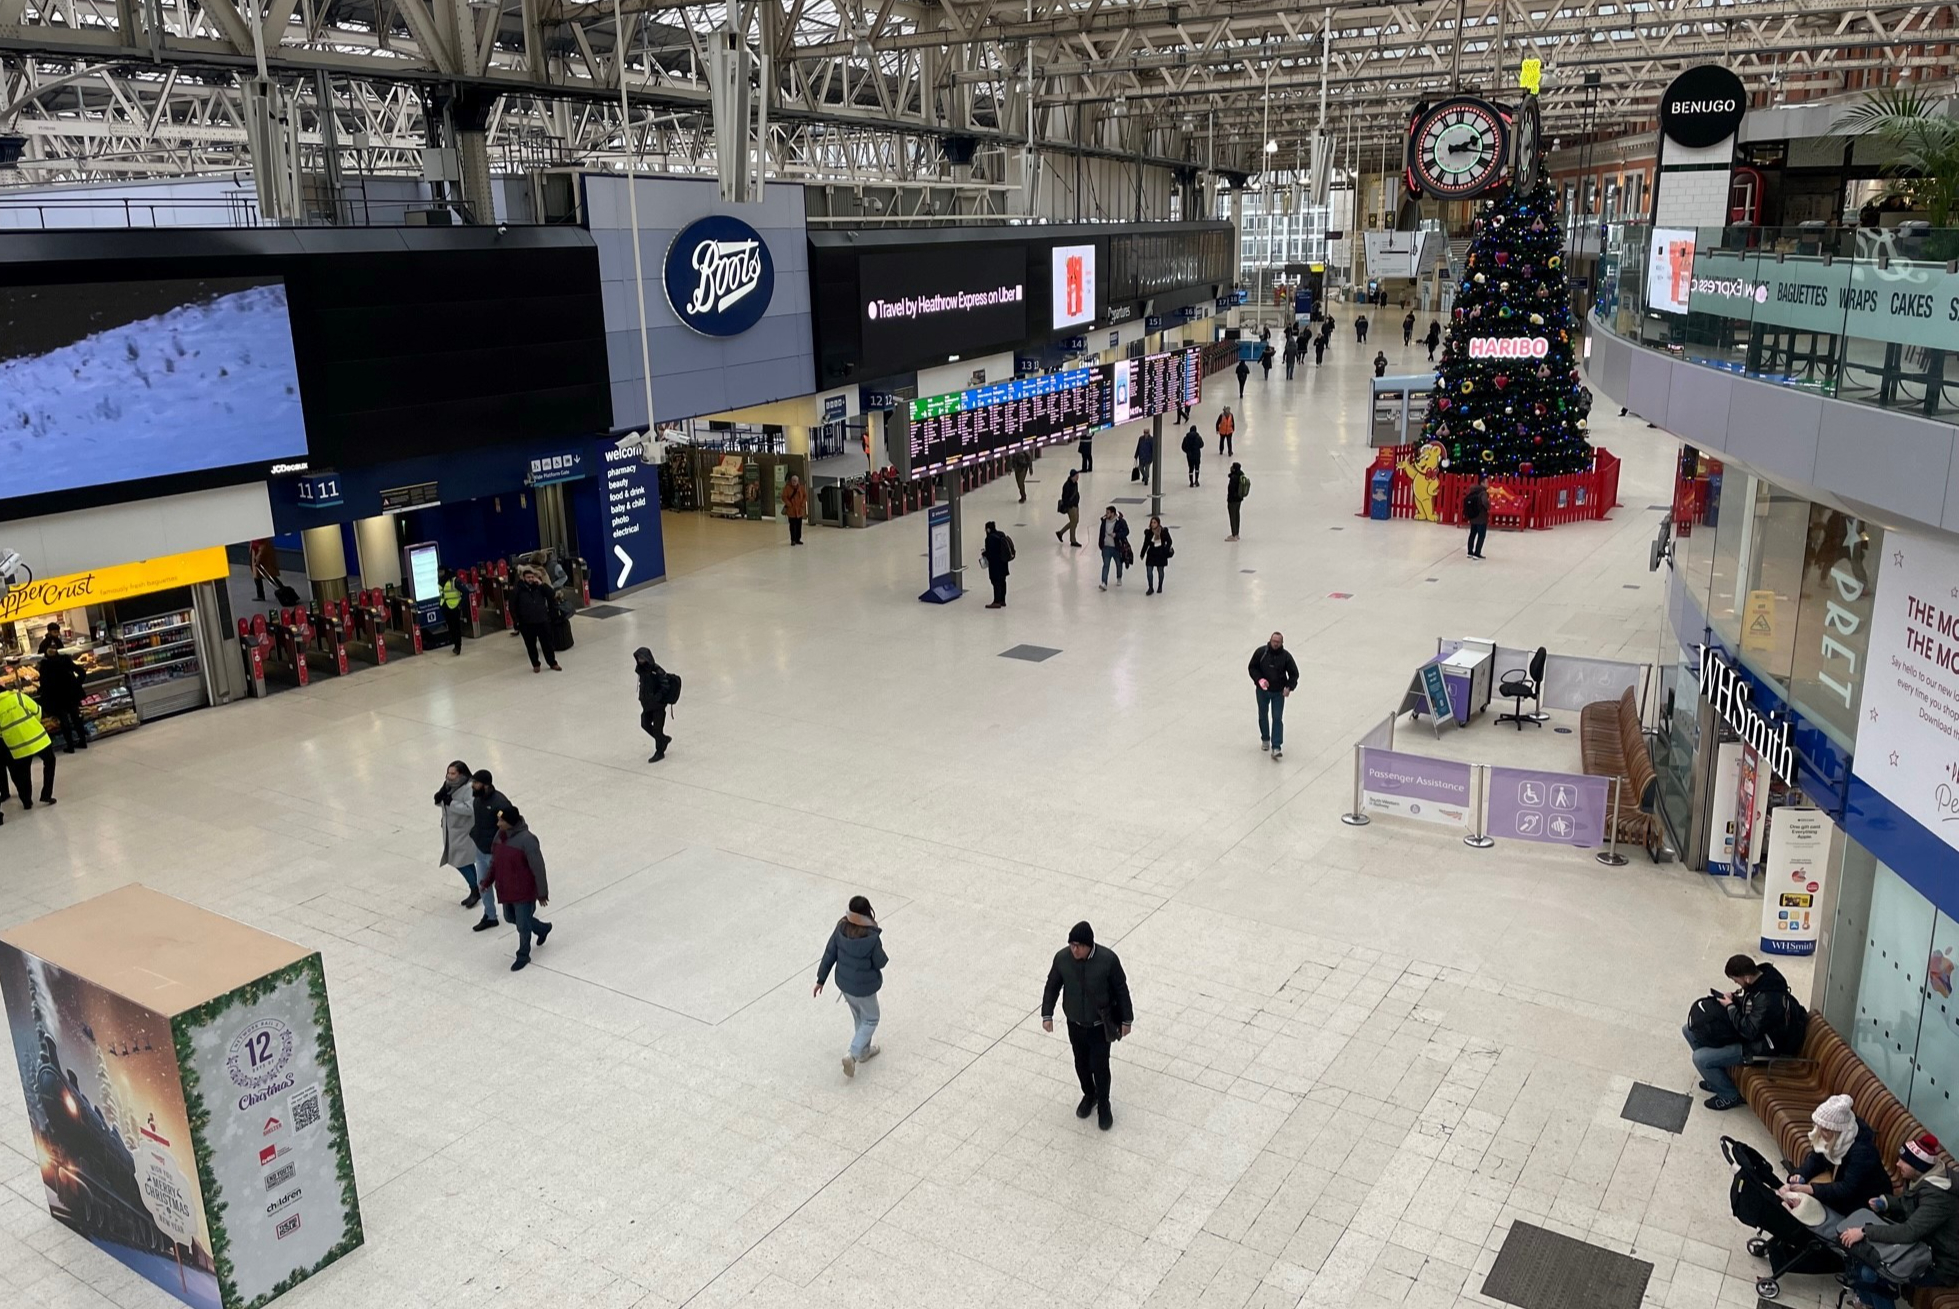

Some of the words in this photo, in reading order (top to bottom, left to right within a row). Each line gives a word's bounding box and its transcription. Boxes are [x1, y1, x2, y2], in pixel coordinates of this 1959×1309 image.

[1671, 98, 1736, 115] BENUGO
[686, 238, 762, 314] Boots
[877, 297, 905, 318] Travel
[905, 297, 918, 319] by
[918, 293, 958, 314] Heathrow
[958, 291, 987, 311] Express
[988, 293, 998, 304] on
[998, 286, 1016, 303] Uber
[1777, 281, 1828, 307] BAGUETTES
[1839, 287, 1878, 313] WRAPS
[1890, 292, 1934, 319] CAKES
[1149, 318, 1158, 326] 15
[1072, 340, 1082, 348] 14
[1469, 337, 1549, 358] HARIBO
[1022, 360, 1032, 370] 13
[870, 395, 883, 406] 12
[885, 394, 892, 406] 12
[605, 446, 642, 462] welcom
[271, 462, 308, 474] JCDecaux
[607, 464, 636, 478] pharmacy
[298, 482, 314, 499] 11
[318, 480, 340, 499] 11
[608, 478, 628, 490] beauty
[610, 492, 624, 502] food
[630, 486, 645, 496] drink
[610, 502, 626, 514] baby
[626, 502, 631, 510] &
[632, 498, 646, 508] child
[612, 514, 630, 528] photo
[612, 523, 640, 538] electrical
[0, 582, 49, 618] pper
[43, 573, 95, 606] Crust
[100, 586, 129, 596] famously
[130, 582, 146, 591] fresh
[1908, 596, 1935, 628] THE
[1818, 566, 1864, 710] PRET
[1906, 626, 1932, 660] THE
[1892, 654, 1902, 671] Say
[1902, 660, 1918, 679] hello
[1918, 670, 1925, 683] to
[1926, 675, 1938, 690] our
[1938, 682, 1953, 697] new
[1898, 677, 1914, 697] every
[1915, 685, 1929, 704] time
[1930, 696, 1942, 712] you
[1700, 642, 1792, 788] WHSmith
[1919, 706, 1952, 737] Download
[1369, 768, 1414, 784] Passenger
[1416, 776, 1465, 792] Assistance
[1772, 940, 1814, 950] WHSmith
[234, 1024, 258, 1048] NETWORK
[244, 1031, 273, 1068] 12
[238, 1072, 295, 1111] Christmas
[152, 1176, 176, 1198] MERRY
[144, 1182, 190, 1218] CHRISTMAS
